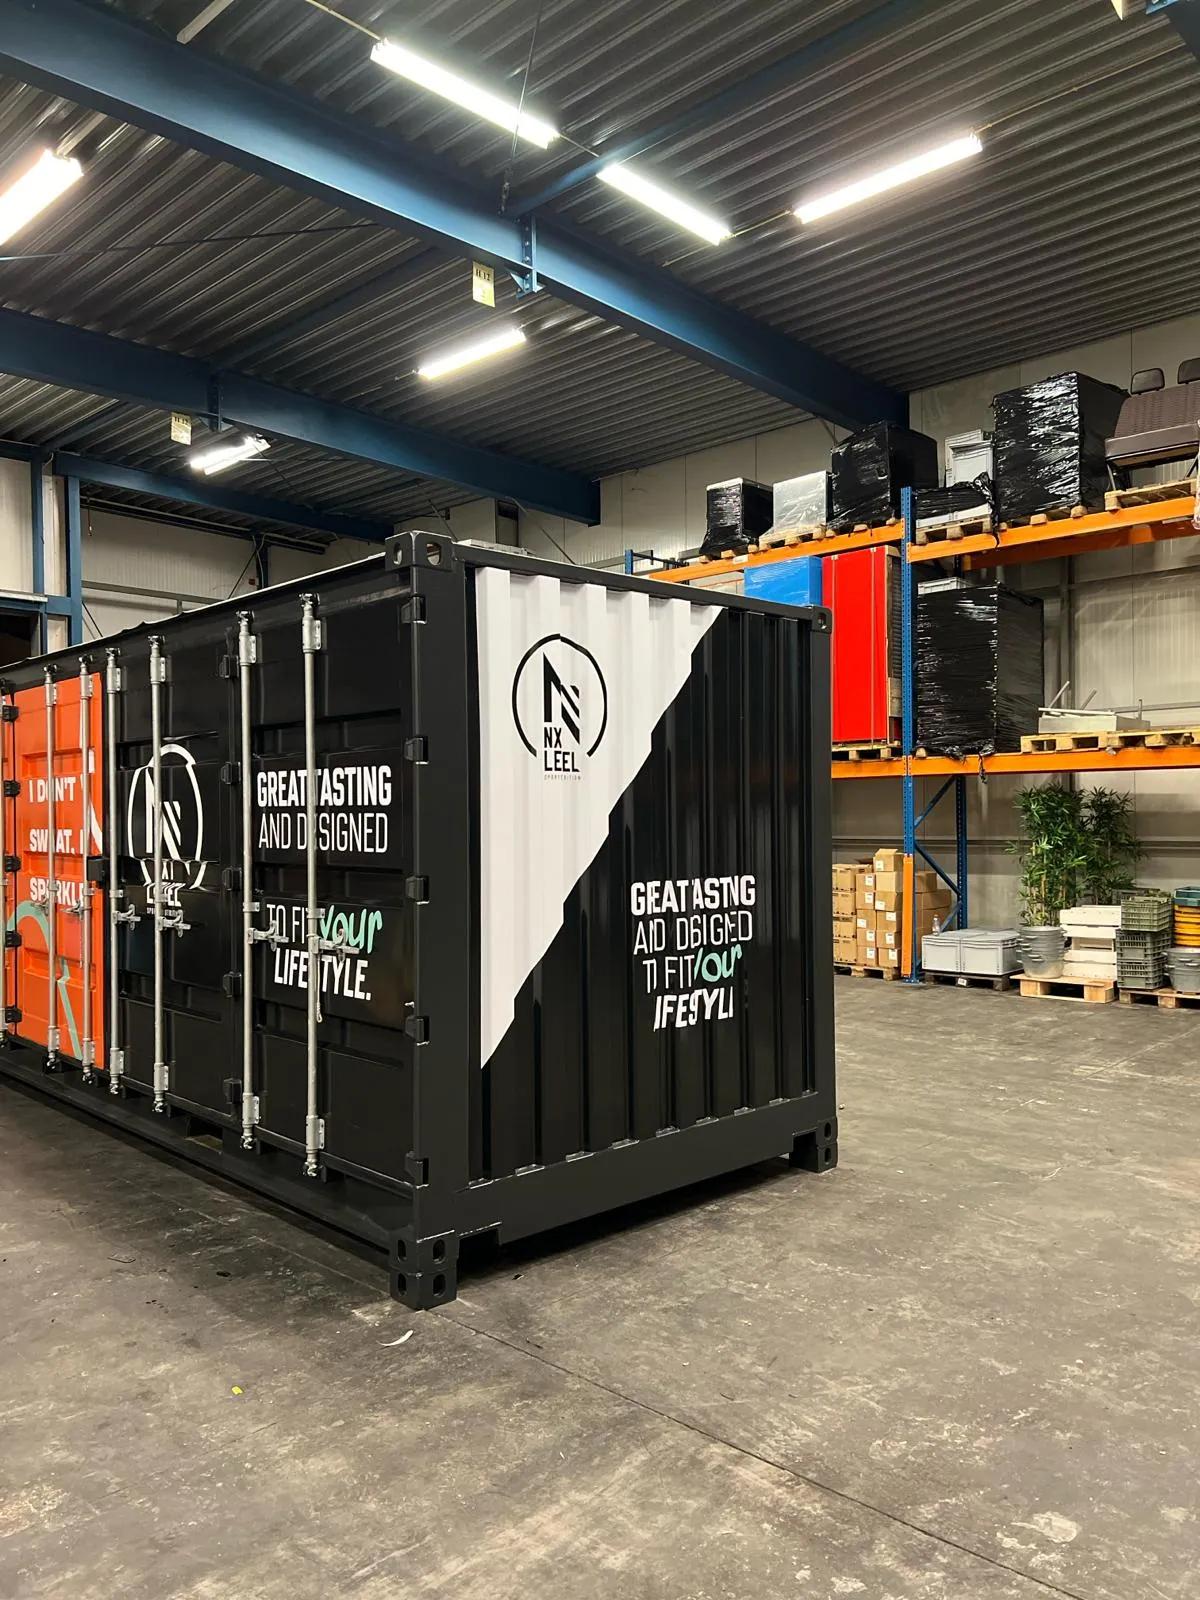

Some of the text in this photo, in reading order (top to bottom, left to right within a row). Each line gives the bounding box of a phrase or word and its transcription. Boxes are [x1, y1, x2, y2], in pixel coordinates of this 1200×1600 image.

[257, 769, 308, 808] GREAT
[258, 812, 388, 853] AND DSIGNED
[292, 906, 309, 944] FI
[274, 947, 372, 1001] LIFETYLE.
[665, 955, 695, 989] FIT
